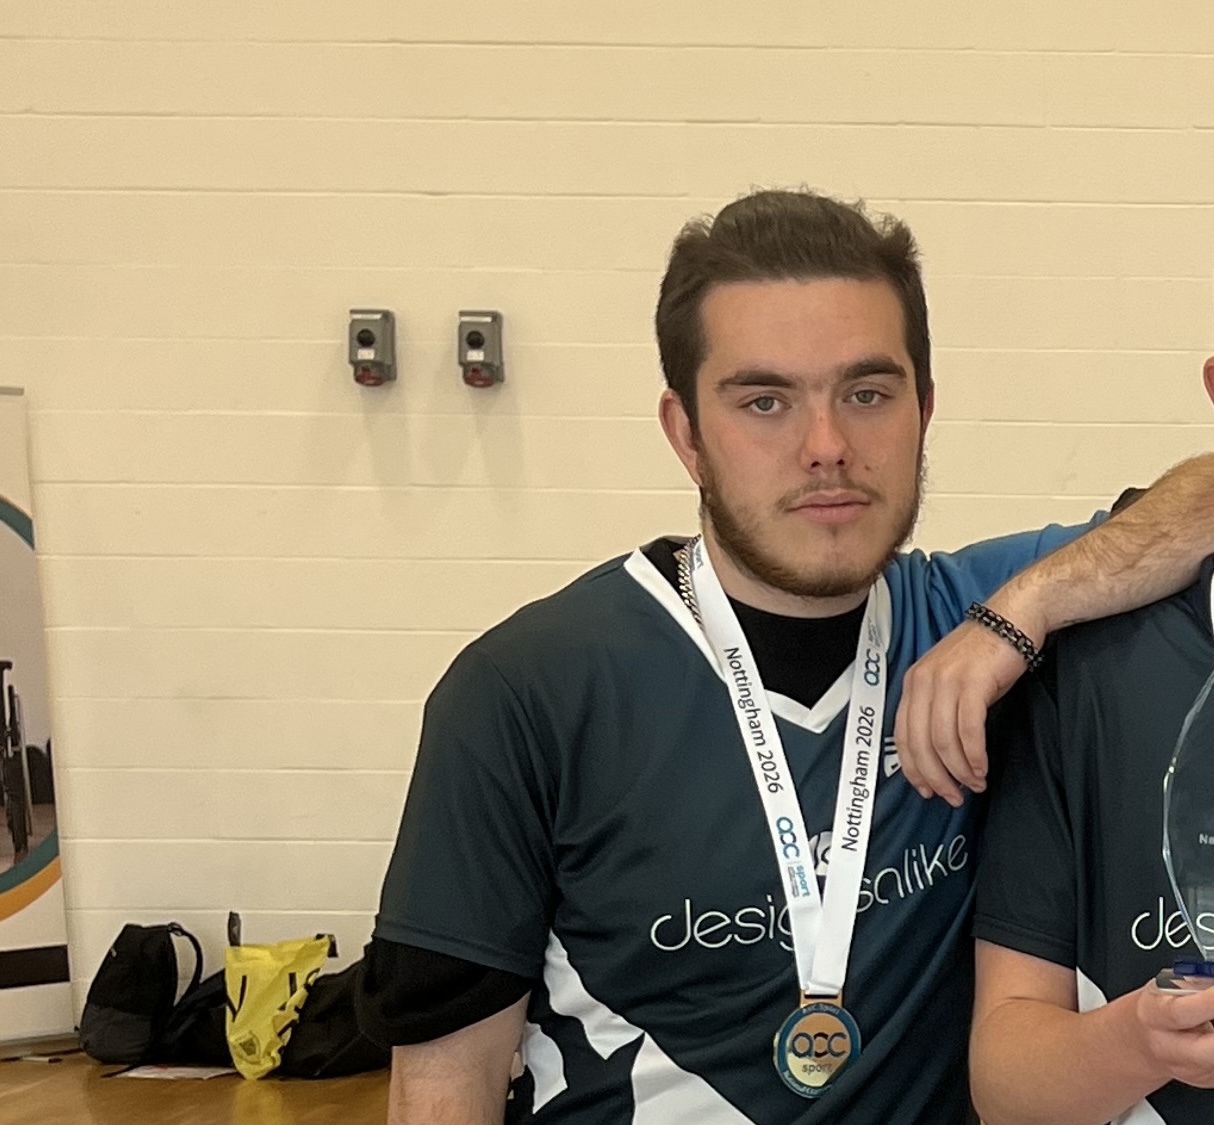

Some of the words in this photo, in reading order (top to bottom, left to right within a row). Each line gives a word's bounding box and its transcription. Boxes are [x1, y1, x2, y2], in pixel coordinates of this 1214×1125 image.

[724, 647, 766, 747] Nottingham
[757, 750, 784, 793] 2026
[855, 705, 876, 747] 2026
[841, 750, 870, 852] Nottingham
[650, 834, 969, 951] desisalike
[801, 1063, 833, 1076] sport
